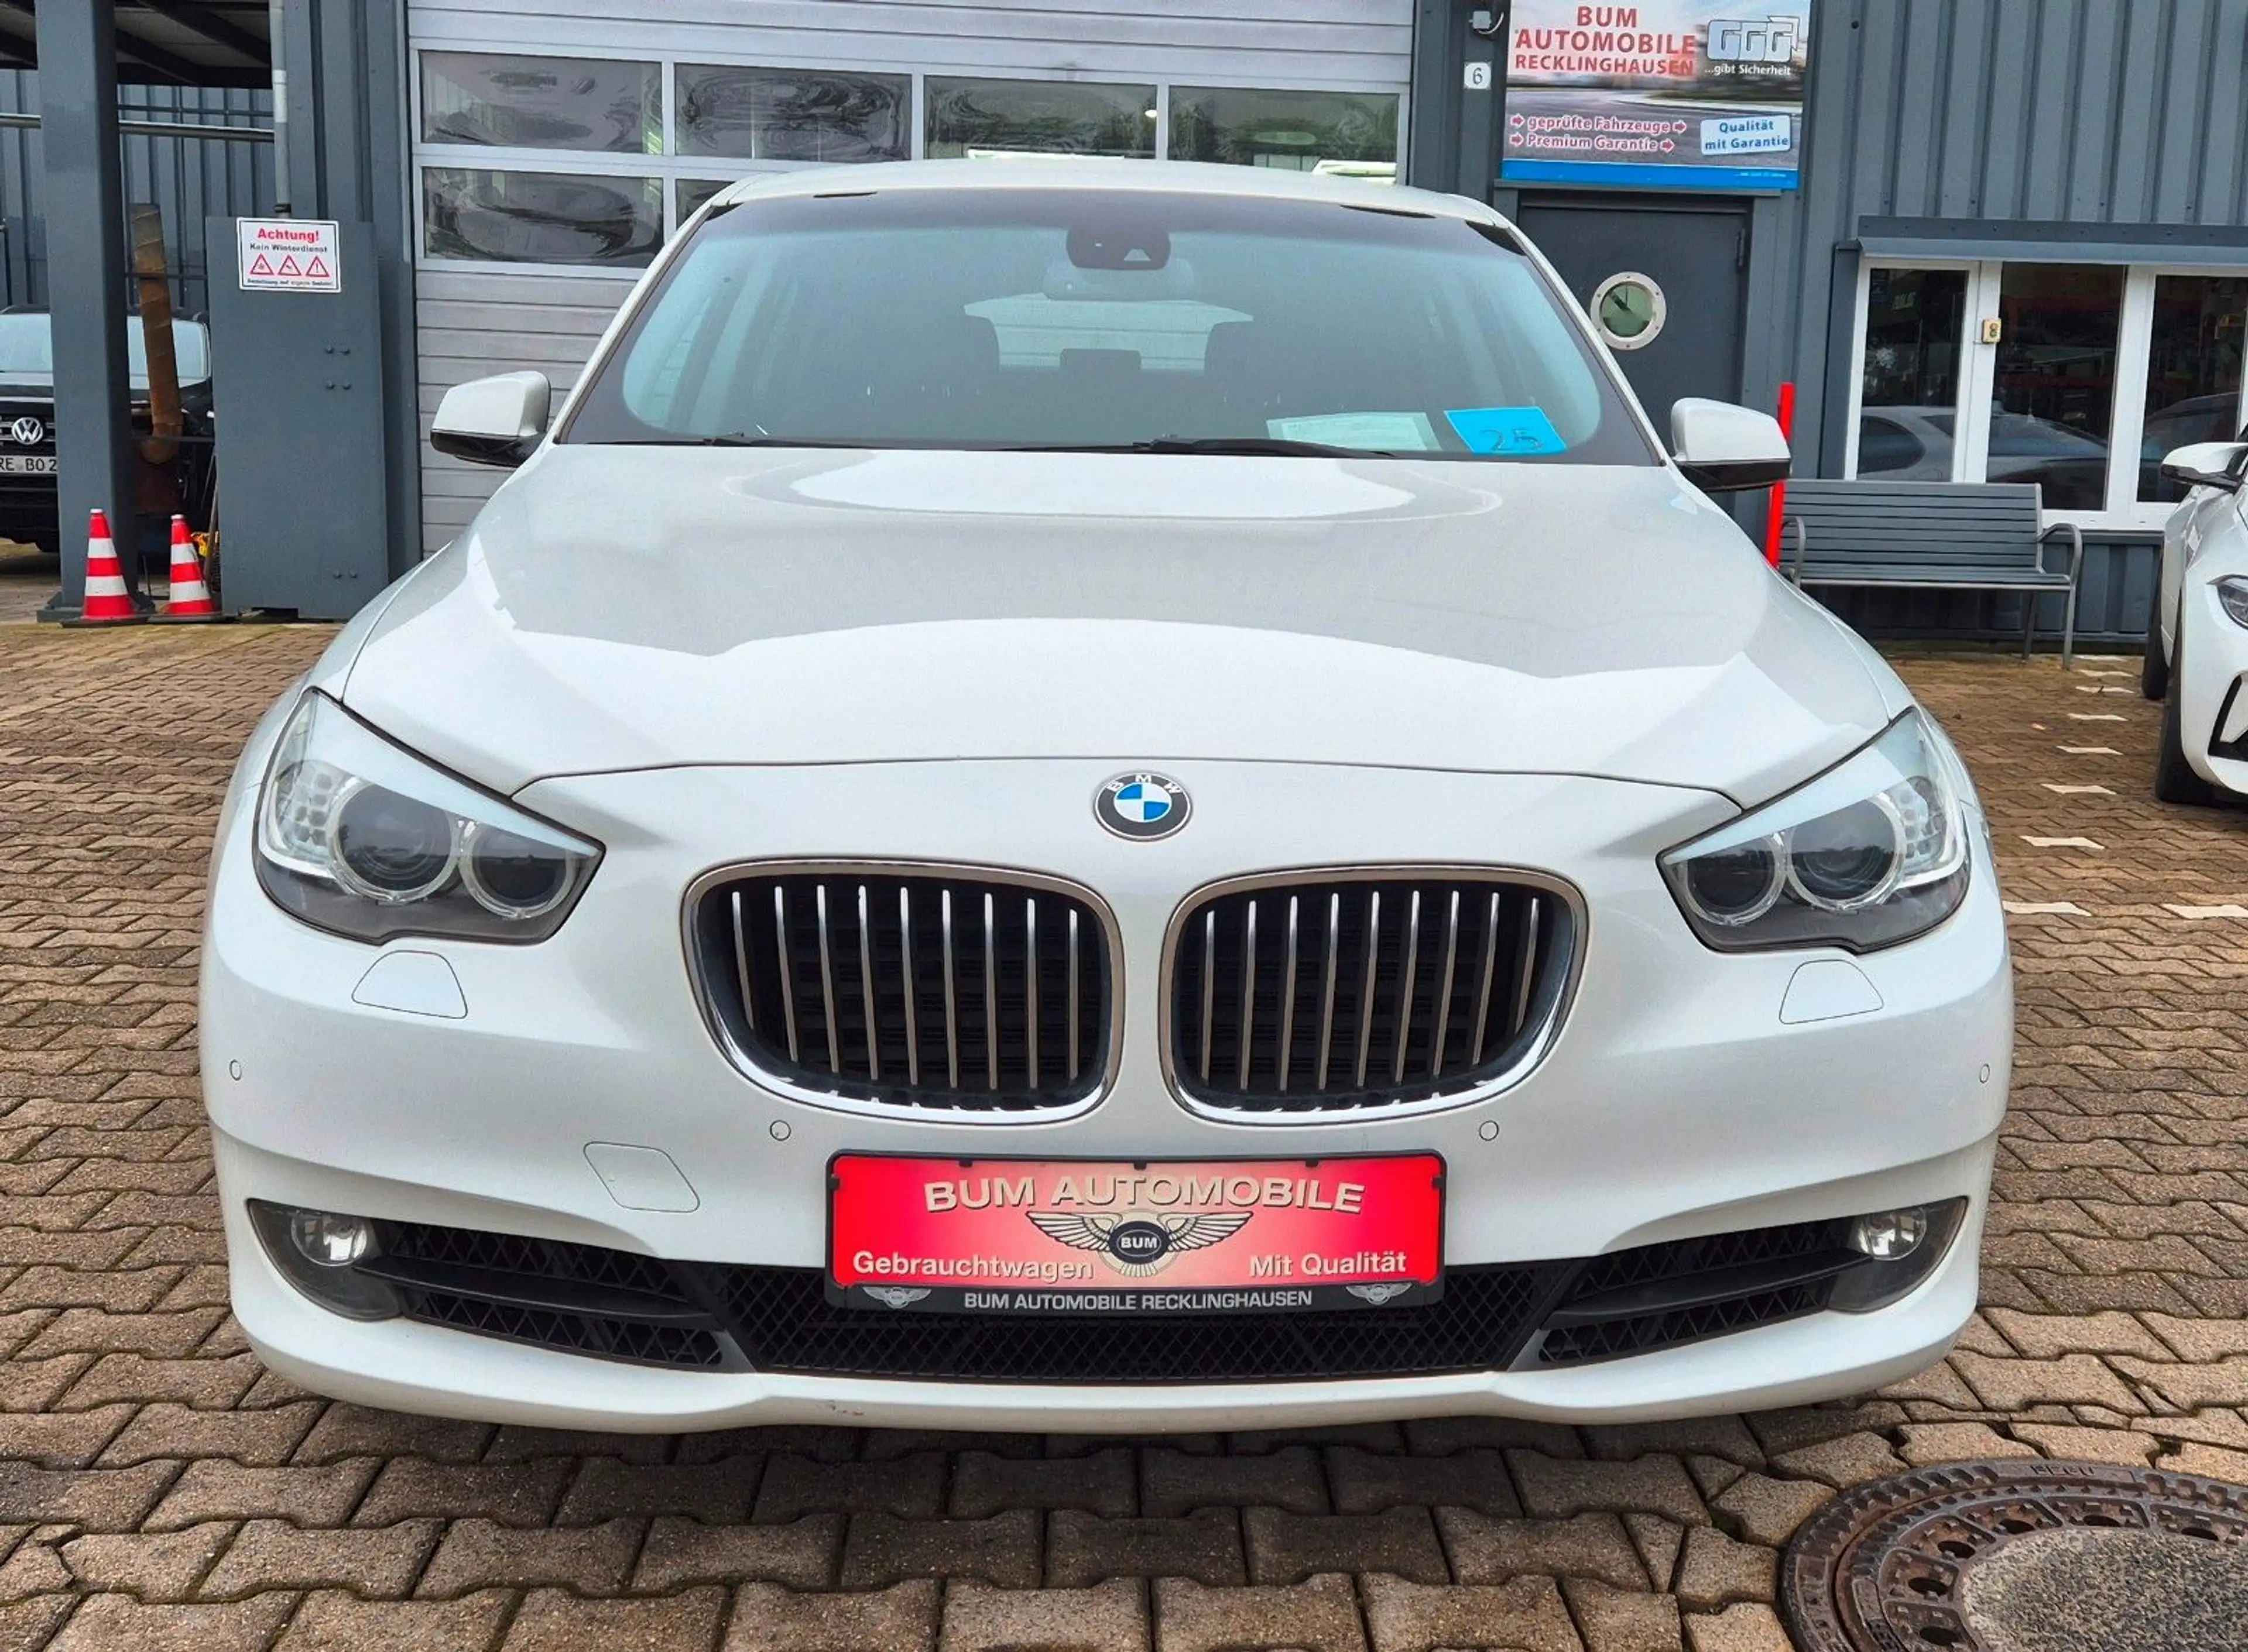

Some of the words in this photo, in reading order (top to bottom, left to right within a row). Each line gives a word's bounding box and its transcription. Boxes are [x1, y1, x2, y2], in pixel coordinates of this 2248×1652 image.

[1577, 6, 1637, 28] BUM
[1515, 29, 1695, 54] AUTOMOBILE
[1515, 54, 1694, 76] RECKLINGHAUSEN
[1739, 64, 1791, 76] Sicherheit
[1472, 67, 1483, 85] 6
[1528, 115, 1592, 130] geprüfte
[1595, 117, 1670, 134] Fahrzeuge
[1719, 119, 1774, 134] Qualität
[1528, 134, 1591, 148] Premium
[1595, 136, 1657, 150] Garantie
[1705, 139, 1726, 150] mit
[1730, 135, 1788, 148] Garantie
[258, 228, 319, 243] Achtung!
[250, 243, 269, 251] Kein
[272, 244, 328, 252] Winterdienst
[1481, 429, 1543, 451] 25
[1106, 773, 1183, 794] BMW
[924, 1177, 1036, 1212] BUM
[1051, 1175, 1366, 1214] AUTOMOBILE
[1120, 1236, 1157, 1249] BUM
[853, 1250, 1094, 1283] Gebrauchtwagen
[1249, 1254, 1293, 1277] Mit
[1300, 1250, 1407, 1276] Qualität
[964, 1292, 1009, 1310] BUM
[1015, 1292, 1137, 1310] AUTOMOBILE
[1142, 1290, 1313, 1310] RECKLINGHAUSEN
